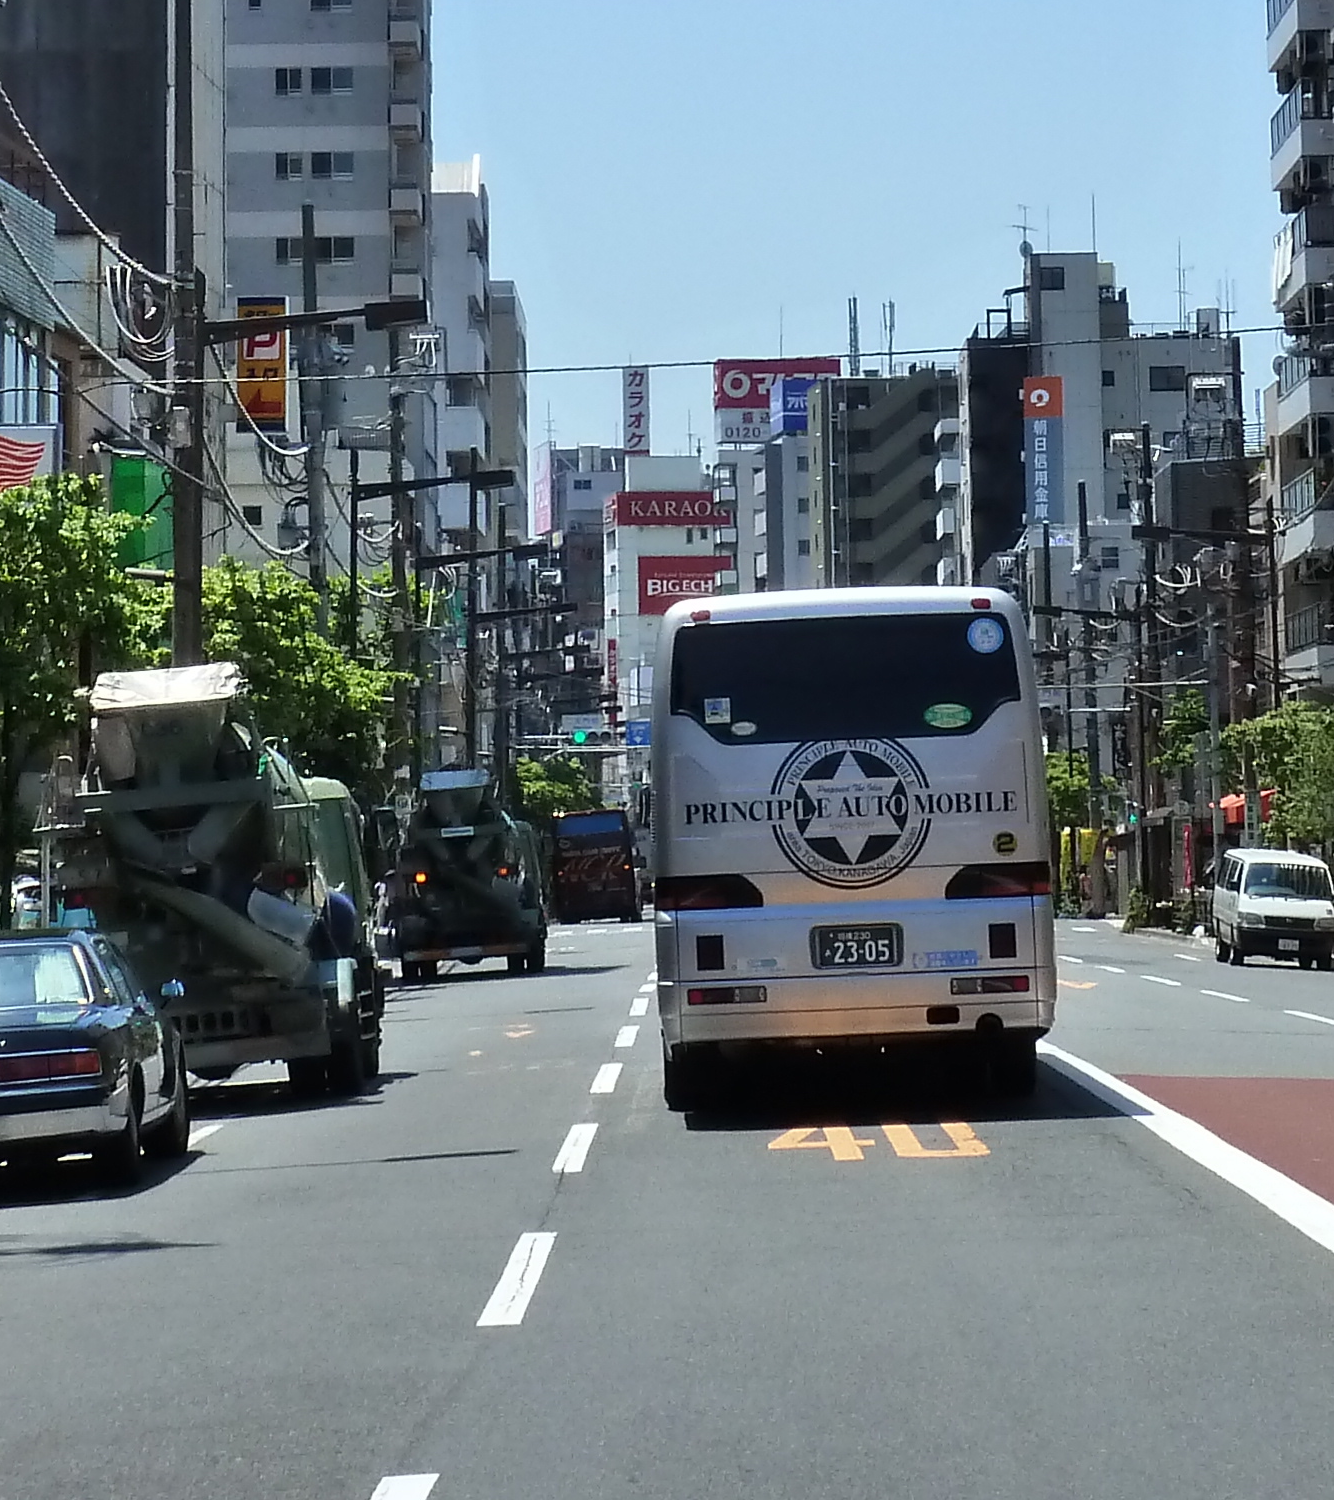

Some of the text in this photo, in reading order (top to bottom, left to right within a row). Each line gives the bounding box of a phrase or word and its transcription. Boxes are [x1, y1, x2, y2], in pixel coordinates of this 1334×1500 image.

[627, 370, 646, 450] カラオケ
[725, 427, 761, 438] 0120
[1033, 419, 1049, 519] 朝日信用金庫
[647, 579, 680, 596] BIG
[786, 739, 839, 787] PRINCIPLE
[880, 747, 916, 787] MOBILE
[685, 790, 1018, 825] PRINCIPLE AUTO MOBILE
[996, 832, 1016, 854] 2
[833, 940, 890, 963] 23-05
